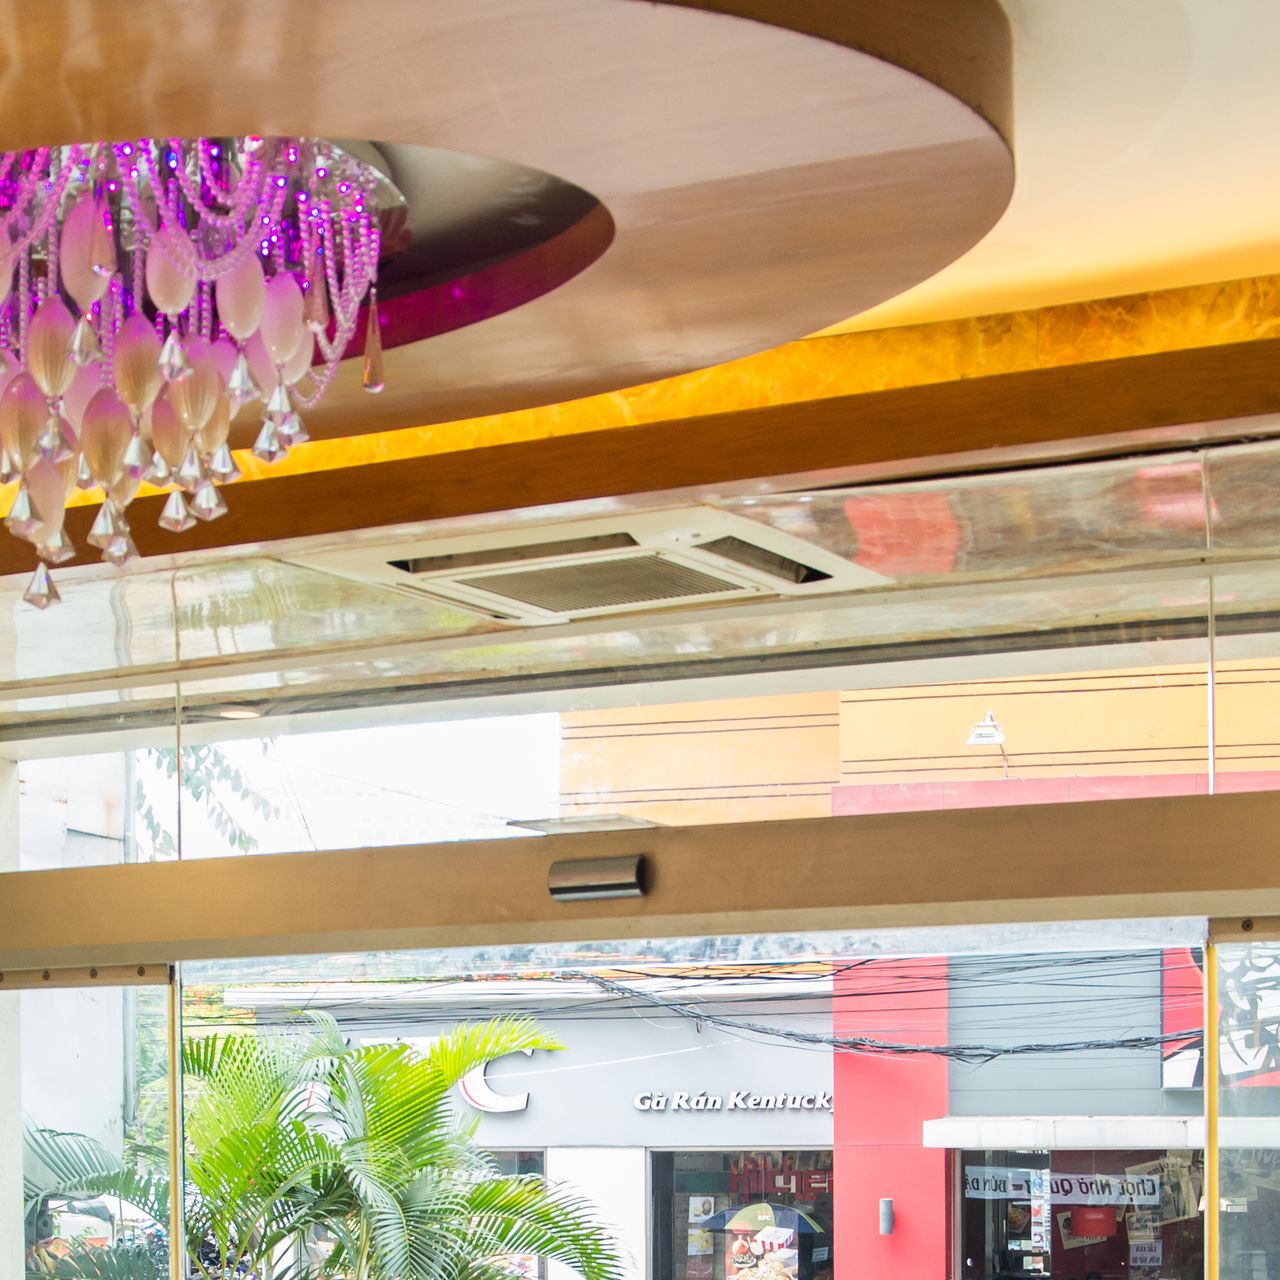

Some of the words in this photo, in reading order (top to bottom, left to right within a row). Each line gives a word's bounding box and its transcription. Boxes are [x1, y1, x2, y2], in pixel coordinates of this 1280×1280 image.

[633, 1090, 668, 1112] Gà
[671, 1089, 722, 1111] Rán
[727, 1090, 834, 1113] Kentuck
